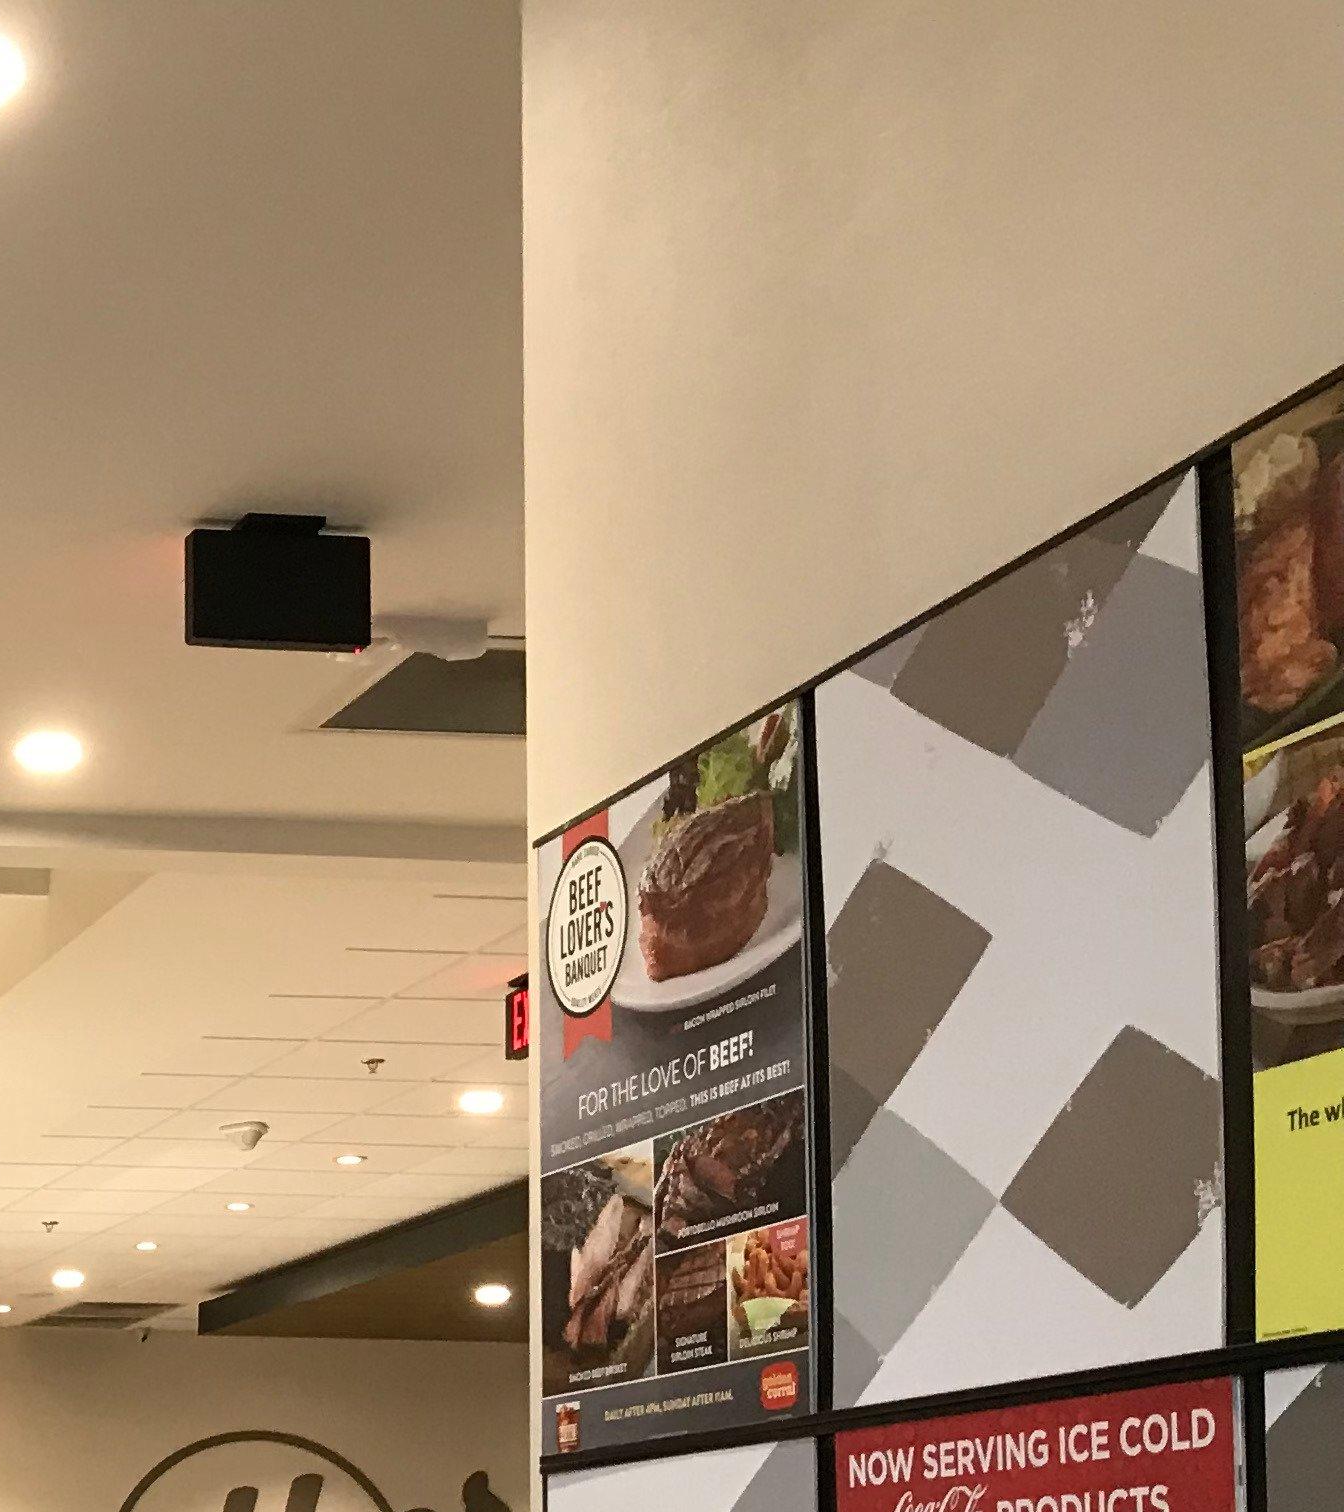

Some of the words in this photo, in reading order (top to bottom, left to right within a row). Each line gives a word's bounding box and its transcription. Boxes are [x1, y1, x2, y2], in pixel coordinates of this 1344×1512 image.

[569, 865, 603, 916] BEEF
[560, 900, 614, 960] LOVER'S
[565, 945, 608, 987] BANQUET
[578, 1088, 609, 1121] FOR
[611, 1074, 639, 1108] THE
[641, 1056, 681, 1098] LOVE
[683, 1047, 708, 1081] OF
[709, 1029, 755, 1072] BEEF!
[690, 1091, 709, 1108] THIS
[709, 1088, 719, 1102] IS
[740, 1075, 751, 1092] AT
[752, 1069, 766, 1086] ITS
[766, 1059, 791, 1081] BEST!
[1286, 1109, 1320, 1133] The
[849, 1445, 915, 1488] NOW
[922, 1430, 1050, 1479] SERVING
[1059, 1421, 1111, 1463] ICE
[1120, 1408, 1216, 1457] COLD
